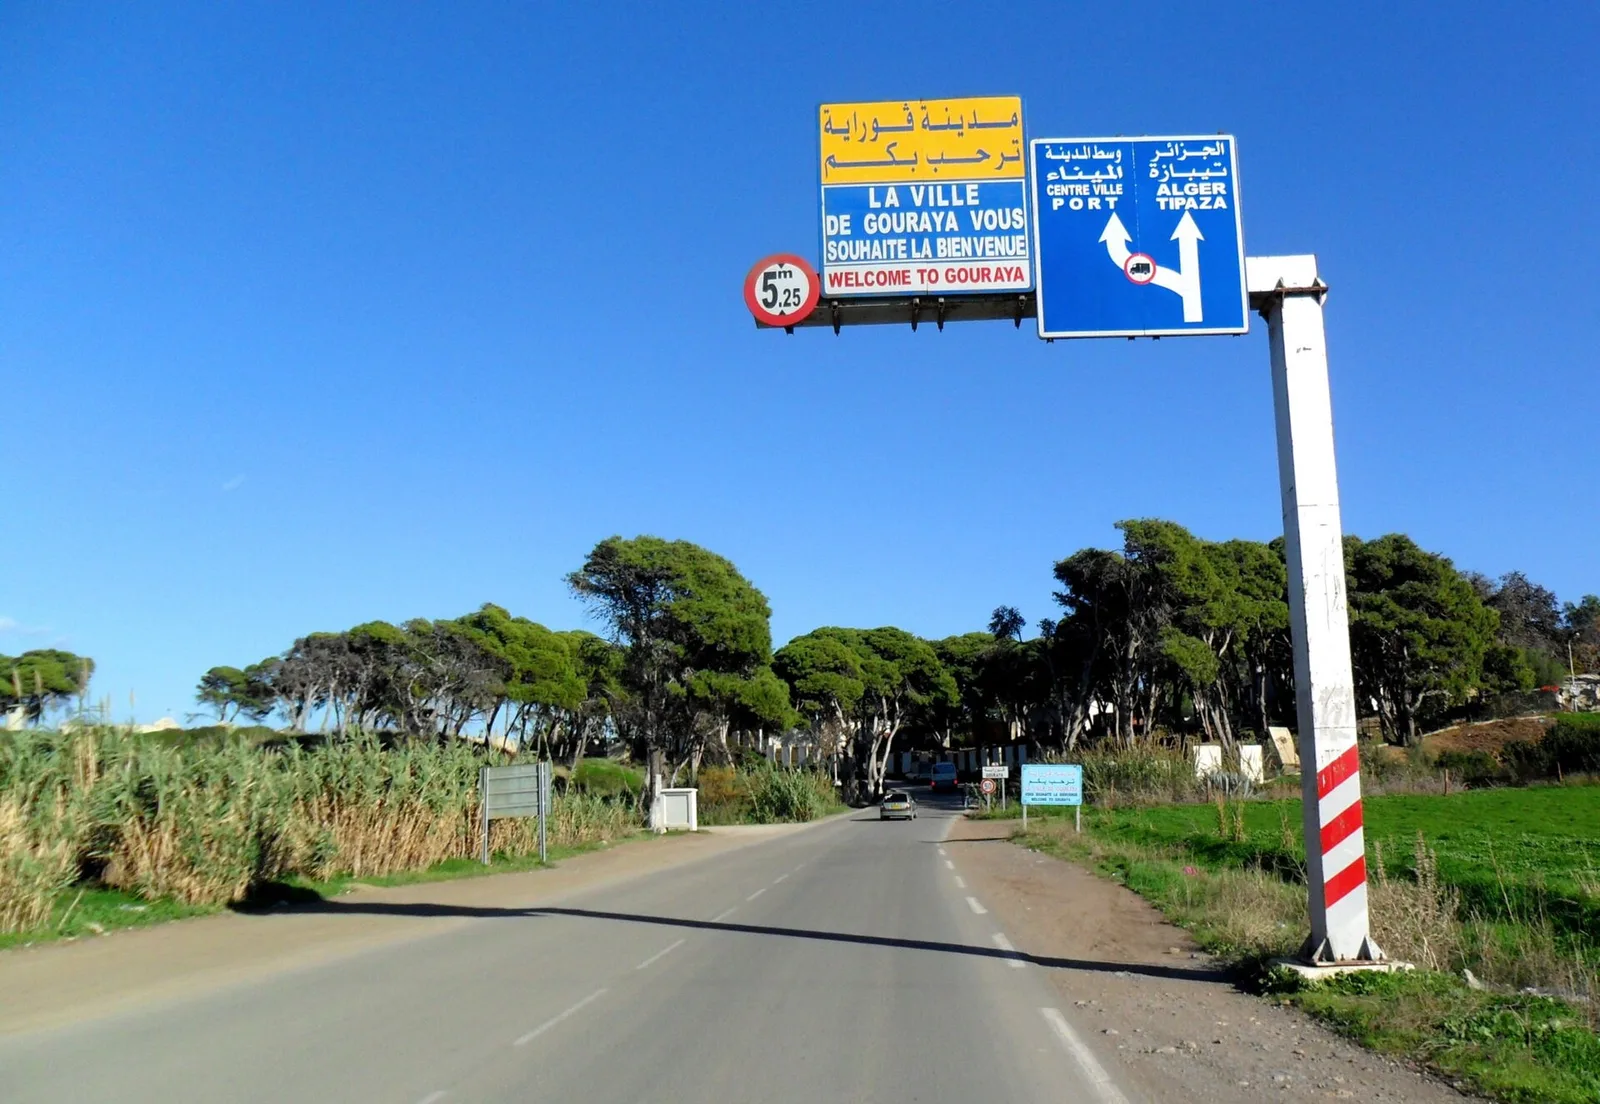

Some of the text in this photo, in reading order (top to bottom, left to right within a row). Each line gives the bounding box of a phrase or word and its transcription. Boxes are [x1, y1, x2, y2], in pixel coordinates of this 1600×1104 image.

[921, 105, 1018, 137] مدينة
[825, 139, 1020, 179] ترحب بكم
[1092, 144, 1122, 164] وسط
[1149, 140, 1225, 162] الجزائر
[1046, 164, 1123, 183] الميناء
[1148, 162, 1228, 183] تيبازة
[869, 184, 980, 209] LA VILLE
[1046, 183, 1124, 196] CENTRE VILLE
[1156, 182, 1228, 196] ALGER
[1052, 196, 1119, 211] PORT
[1155, 195, 1228, 211] TIPAZA
[826, 207, 1024, 236] DE GOURAYA VOUS
[827, 234, 1026, 261] SOUHAITE LA BIENVENUE
[828, 266, 1025, 288] WELCOME TO GOURAYA
